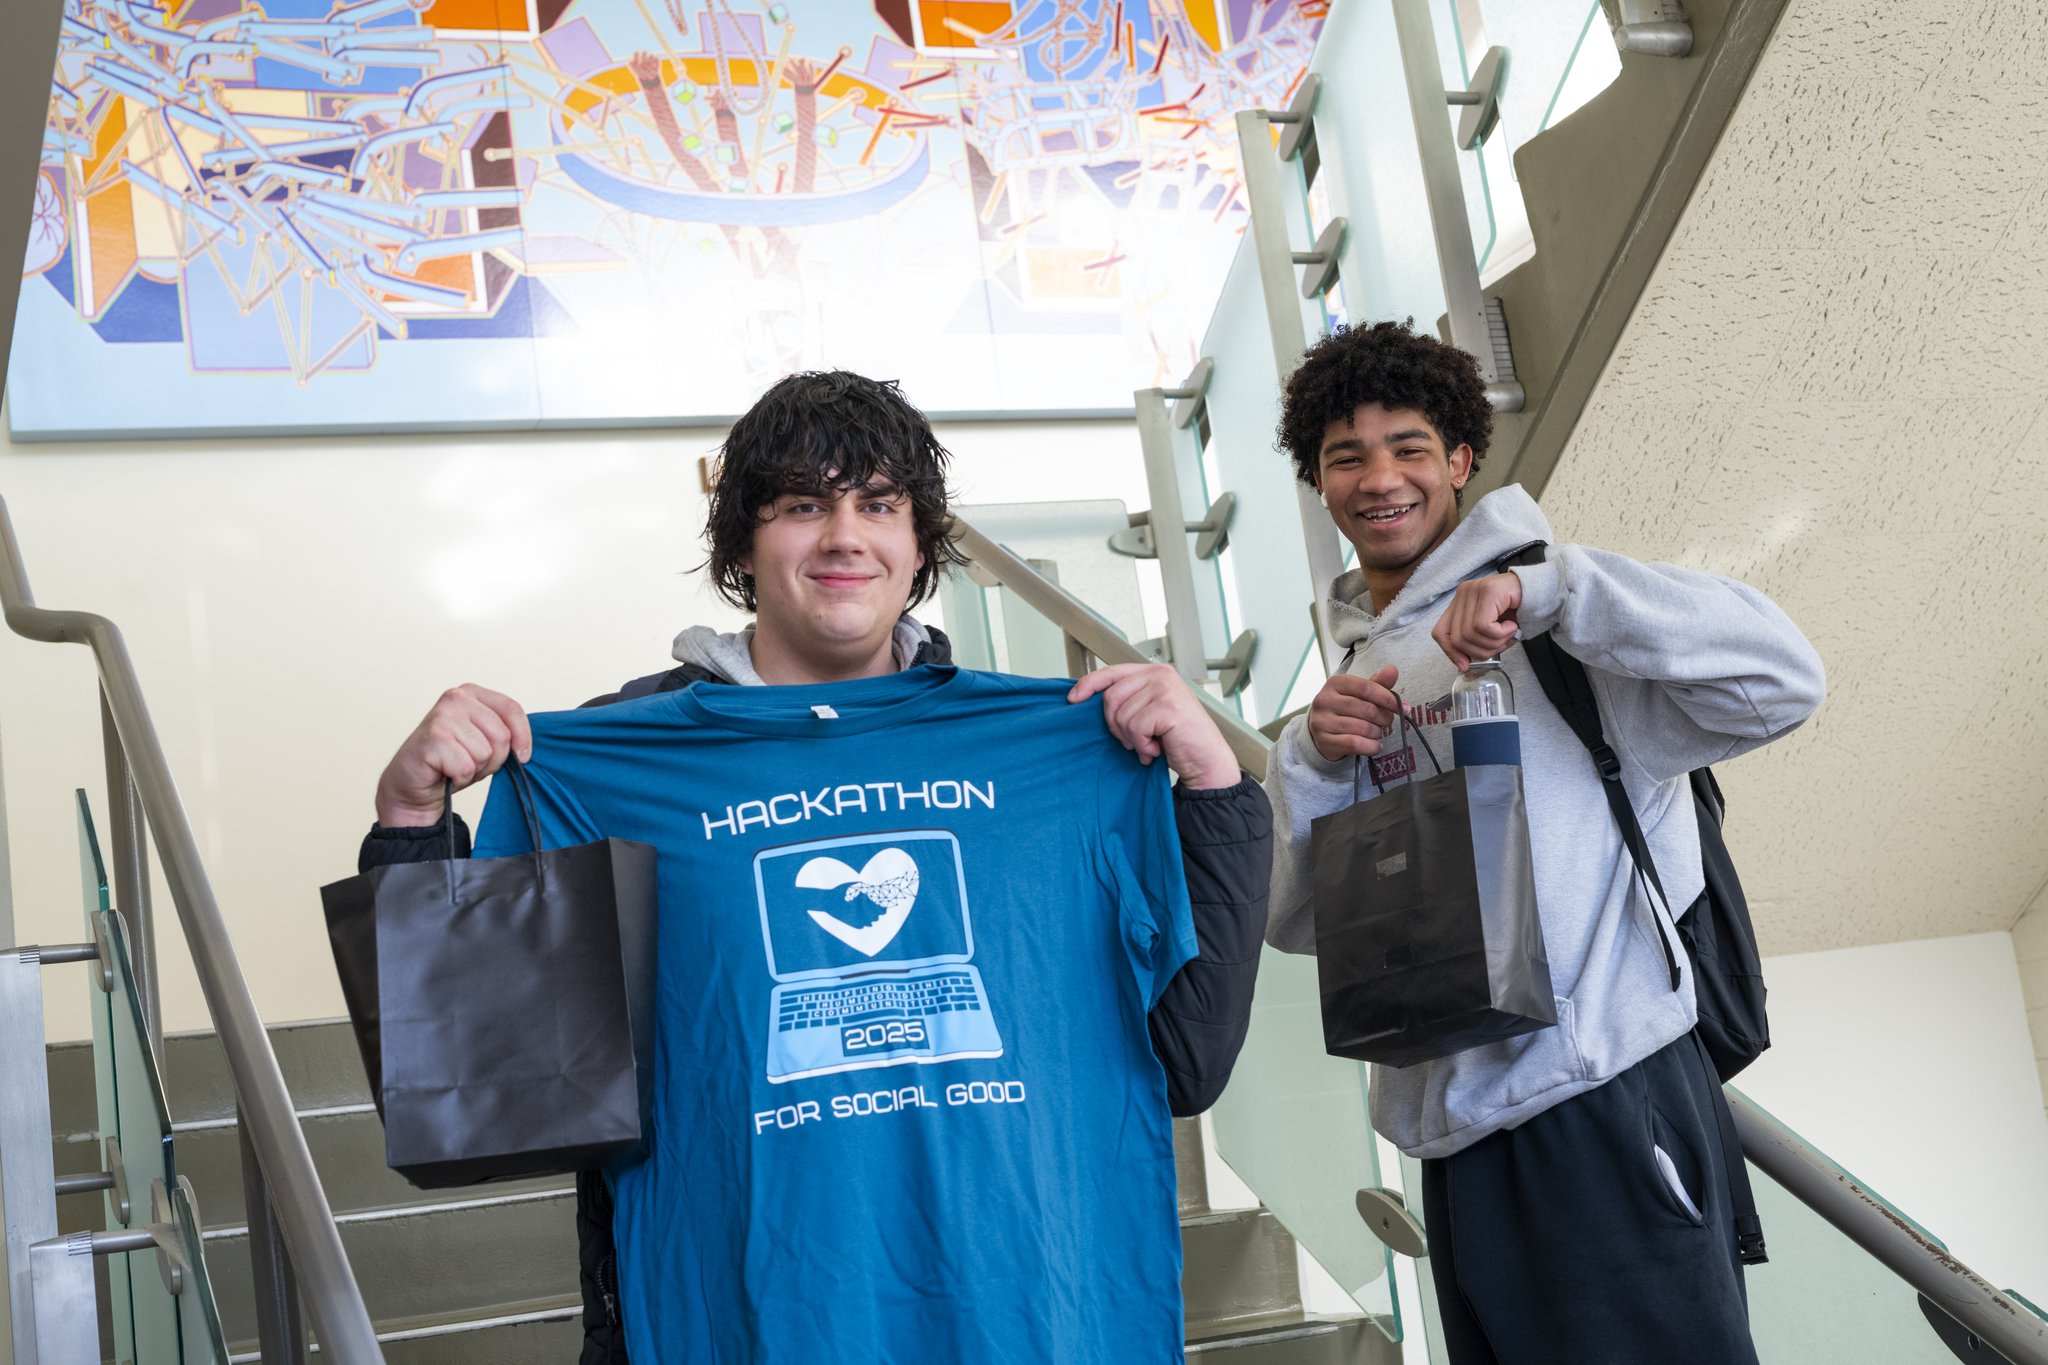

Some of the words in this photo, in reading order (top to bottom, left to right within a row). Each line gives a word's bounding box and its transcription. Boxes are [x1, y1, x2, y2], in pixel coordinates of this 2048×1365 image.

[702, 781, 995, 839] HACKATHON
[803, 985, 892, 1002] HELPING
[911, 980, 945, 990] THE
[822, 991, 922, 1008] HUMBOLDT
[813, 999, 931, 1018] COMMUNITY
[845, 1022, 924, 1049] 2025
[755, 1101, 821, 1135] FOR
[831, 1086, 938, 1118] SOCIAL
[946, 1081, 1025, 1105] GOOD
